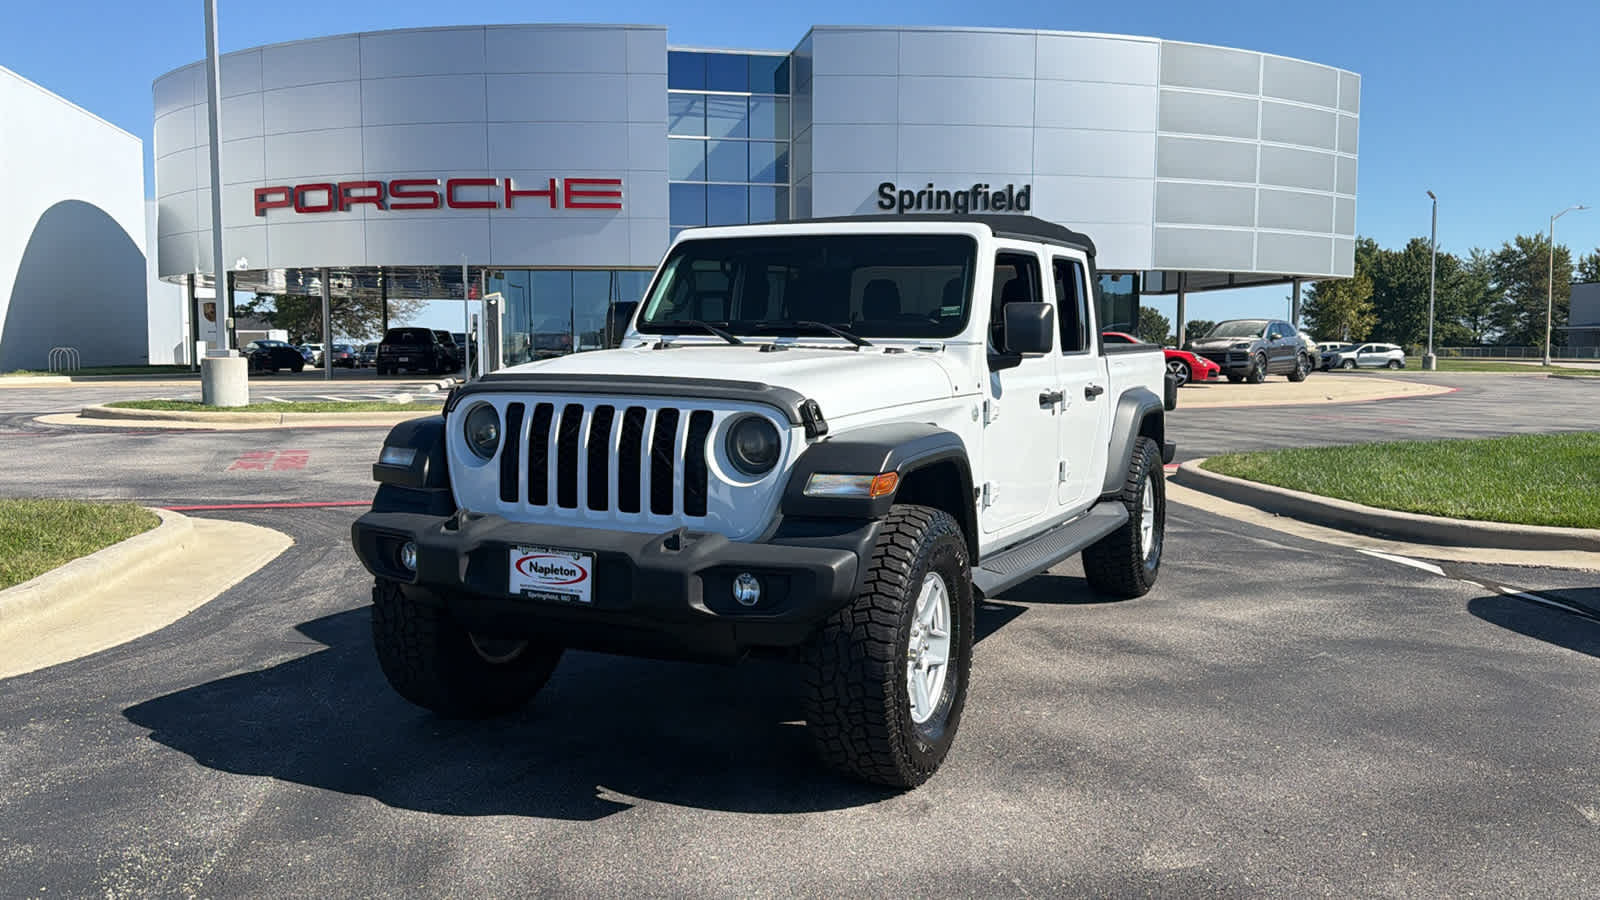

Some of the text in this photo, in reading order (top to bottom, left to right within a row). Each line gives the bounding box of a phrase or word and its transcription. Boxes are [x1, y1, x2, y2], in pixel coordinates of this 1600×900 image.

[254, 178, 622, 217] PORSCHE
[877, 182, 1031, 215] Springfield
[529, 561, 577, 577] Napleton
